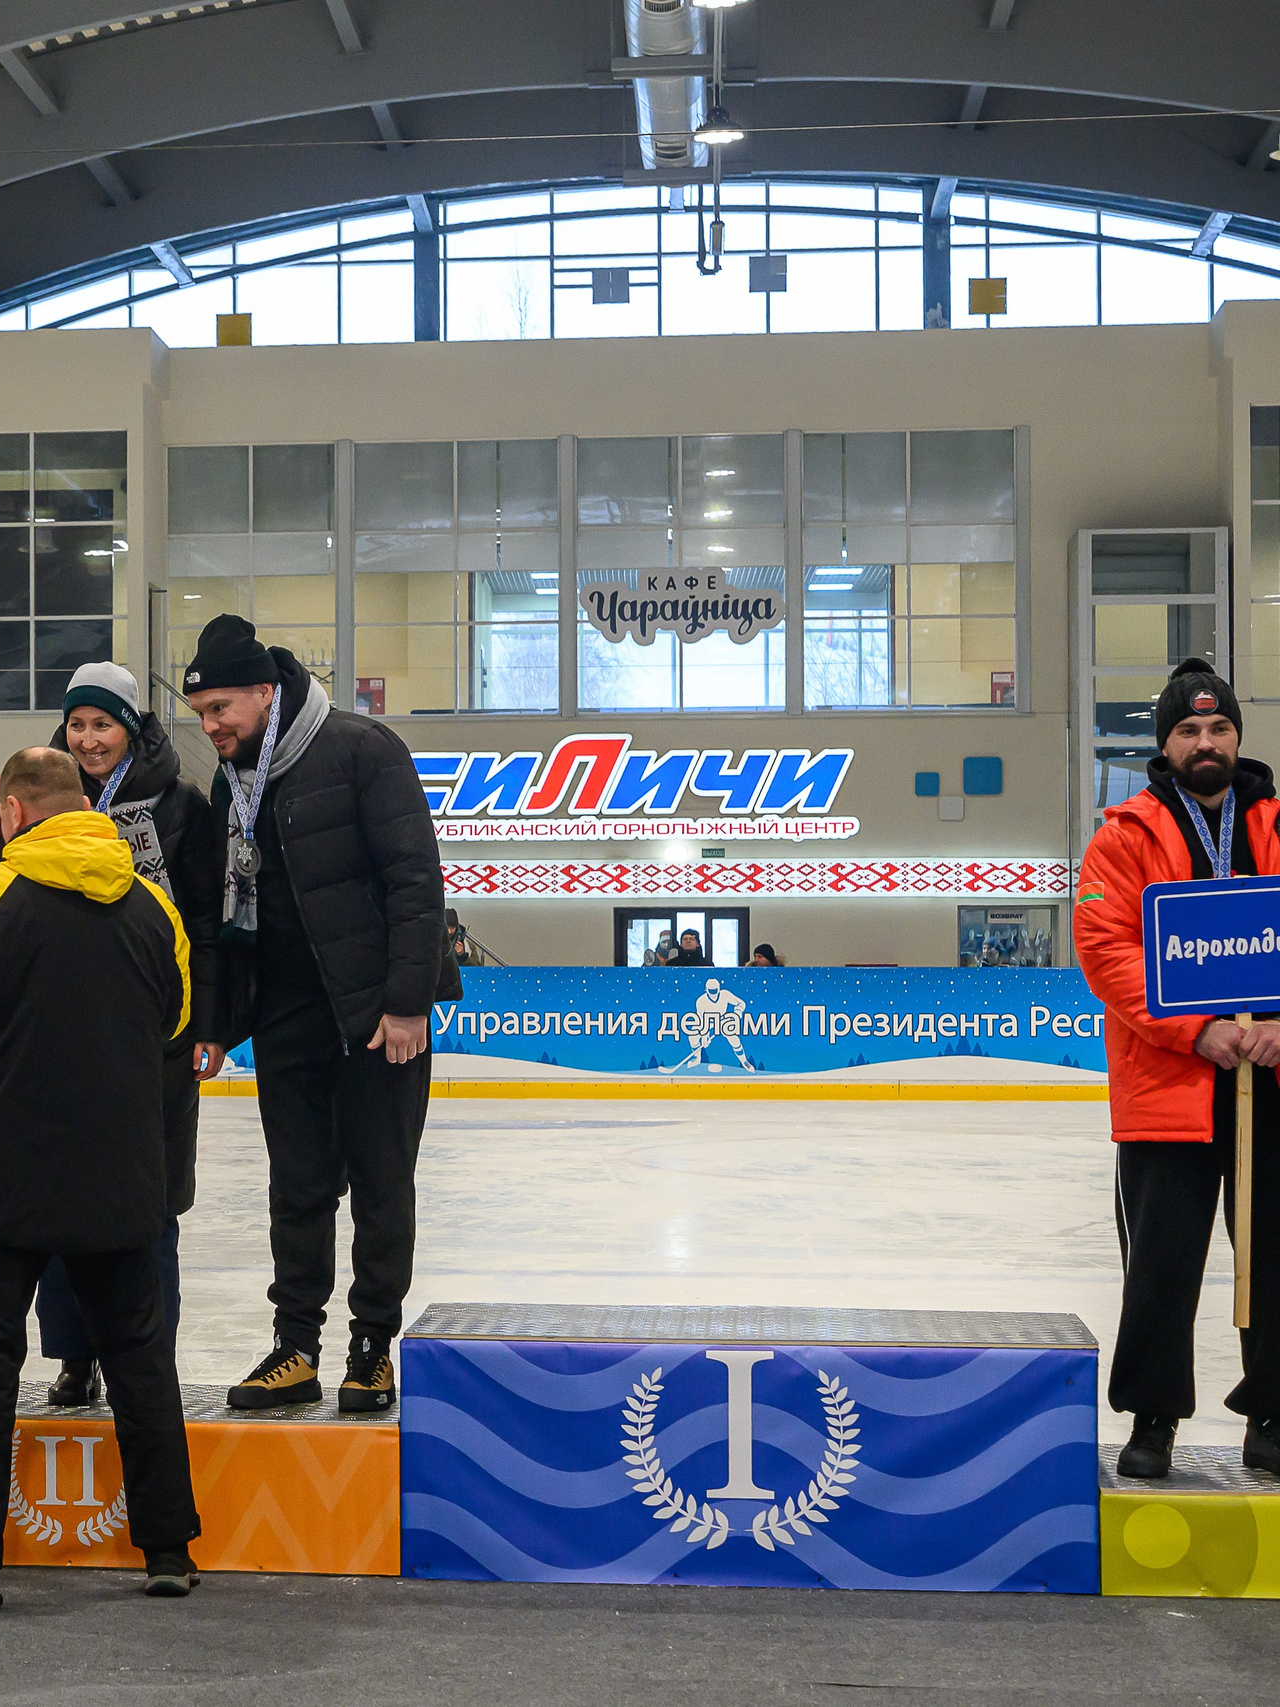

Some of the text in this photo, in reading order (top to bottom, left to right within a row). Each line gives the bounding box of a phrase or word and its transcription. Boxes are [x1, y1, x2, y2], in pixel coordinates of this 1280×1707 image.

[647, 576, 717, 590] КАФЕ
[589, 591, 777, 637] Чараўніца
[601, 819, 779, 836] ГОРНОЛЫЖНЫЙ
[785, 821, 855, 837] ЦЕНТР
[1165, 927, 1280, 966] Агрохолд
[433, 1004, 648, 1043] Управления
[657, 1011, 792, 1042] делами
[802, 1005, 1018, 1044] Президента
[34, 1435, 104, 1506] II
